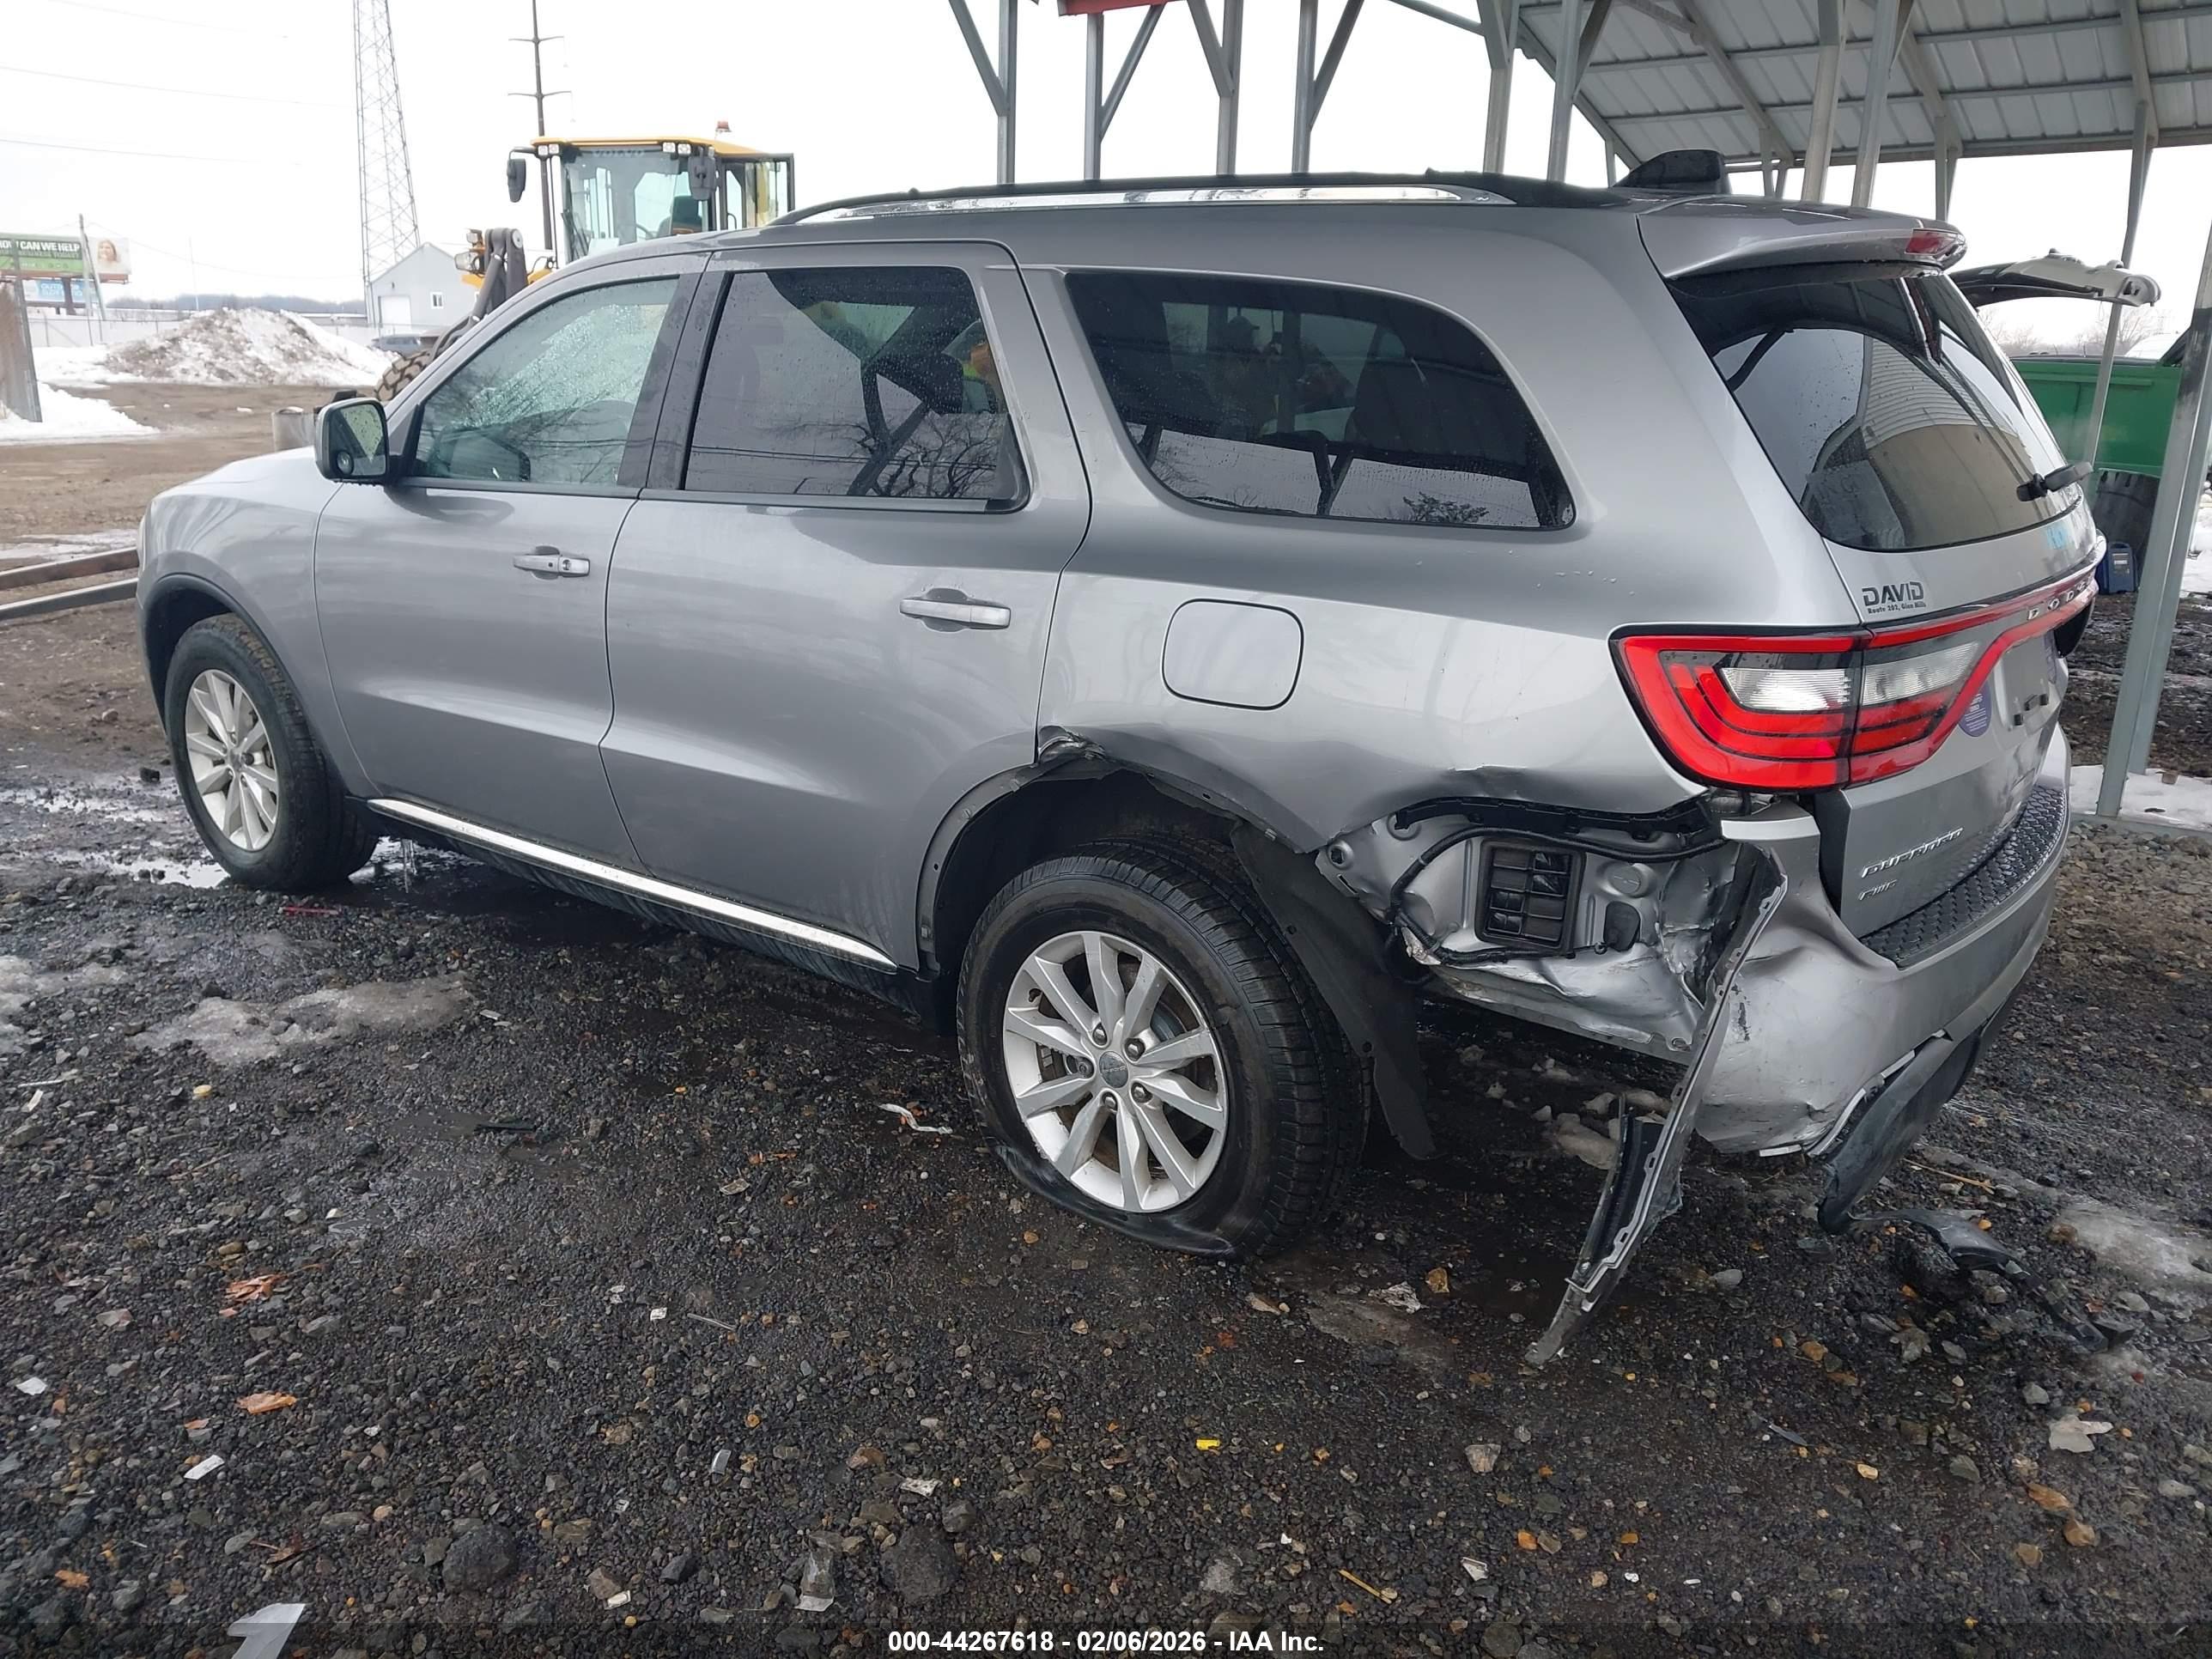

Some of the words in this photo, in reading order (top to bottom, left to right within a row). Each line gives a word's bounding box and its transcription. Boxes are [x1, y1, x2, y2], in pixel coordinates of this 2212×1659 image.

[20, 240, 40, 251] CAN
[40, 241, 58, 252] WE
[58, 242, 81, 252] HELP
[1862, 581, 1924, 606] DAVID
[1868, 605, 1887, 614] Route
